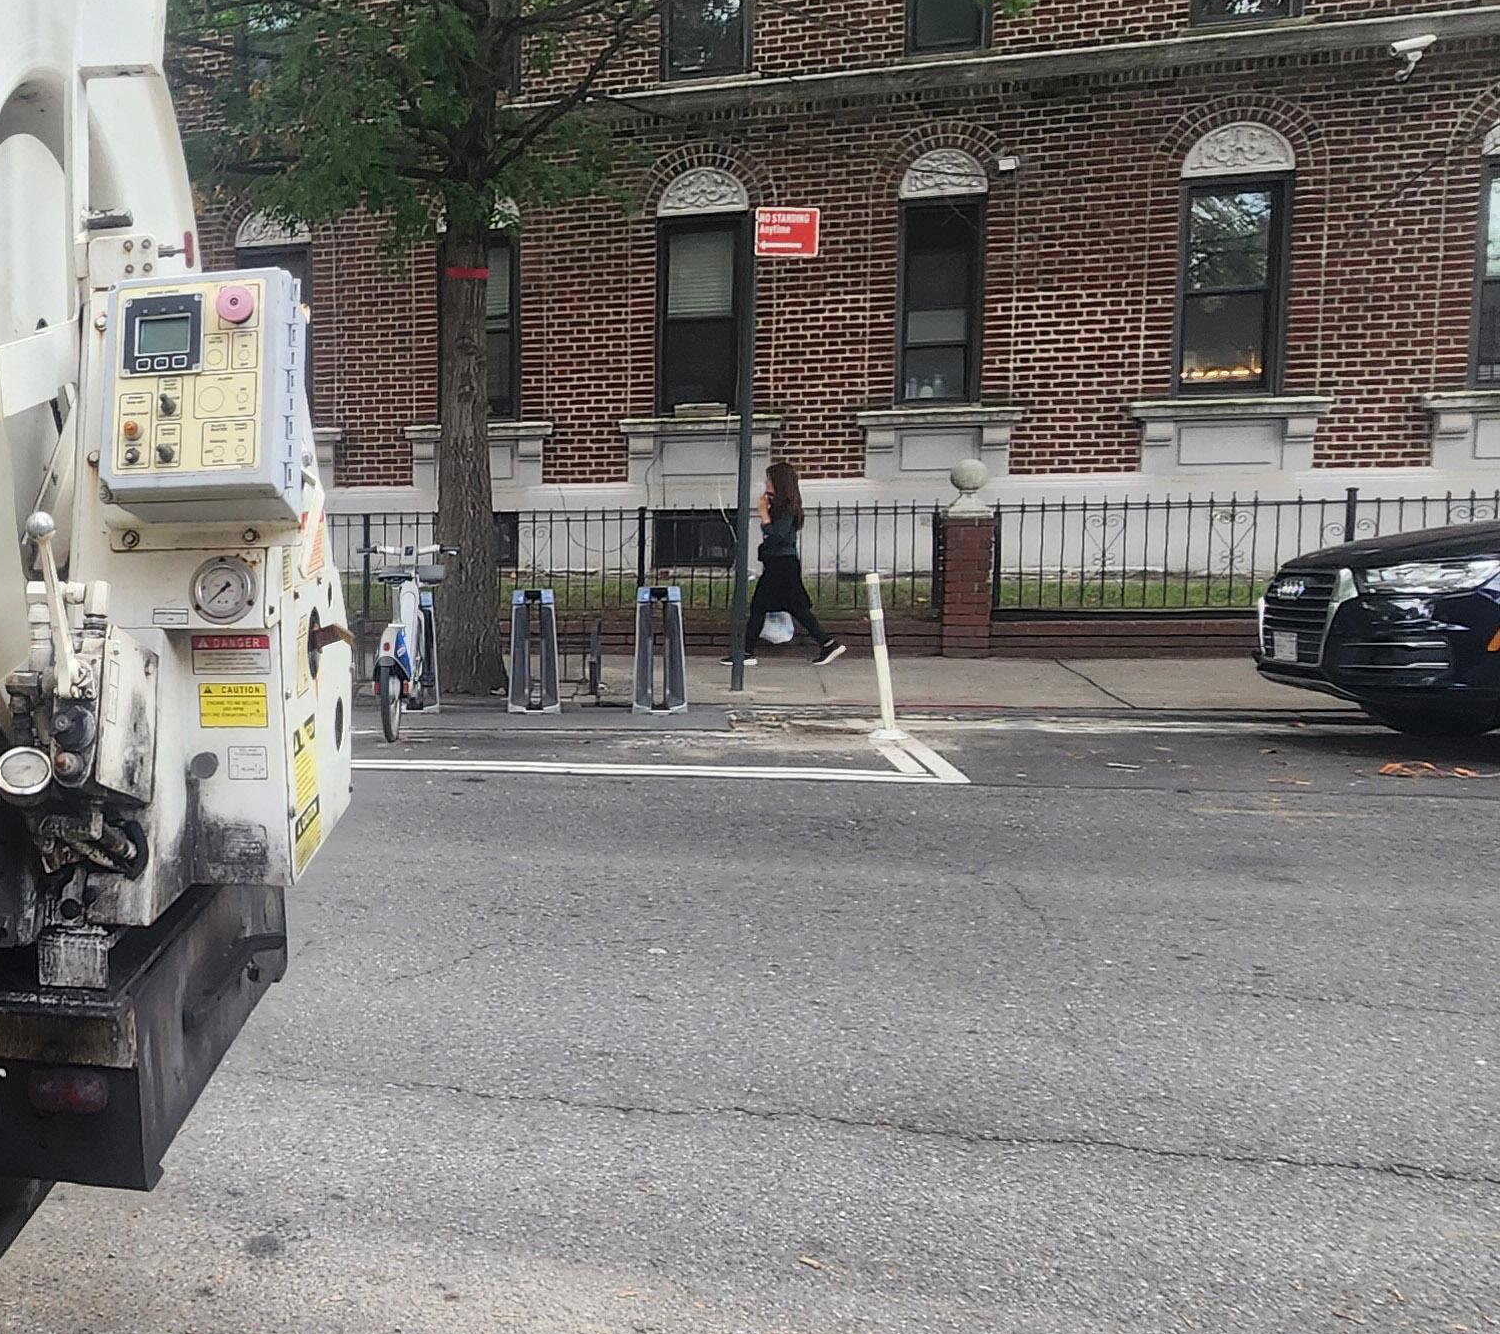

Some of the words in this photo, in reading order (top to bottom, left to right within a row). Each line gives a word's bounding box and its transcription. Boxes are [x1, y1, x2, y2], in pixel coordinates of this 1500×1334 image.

[759, 213, 771, 223] NO
[772, 214, 810, 223] STANDING
[759, 224, 791, 235] Anytime
[213, 638, 260, 647] DANGER
[221, 686, 260, 694] CAUTION
